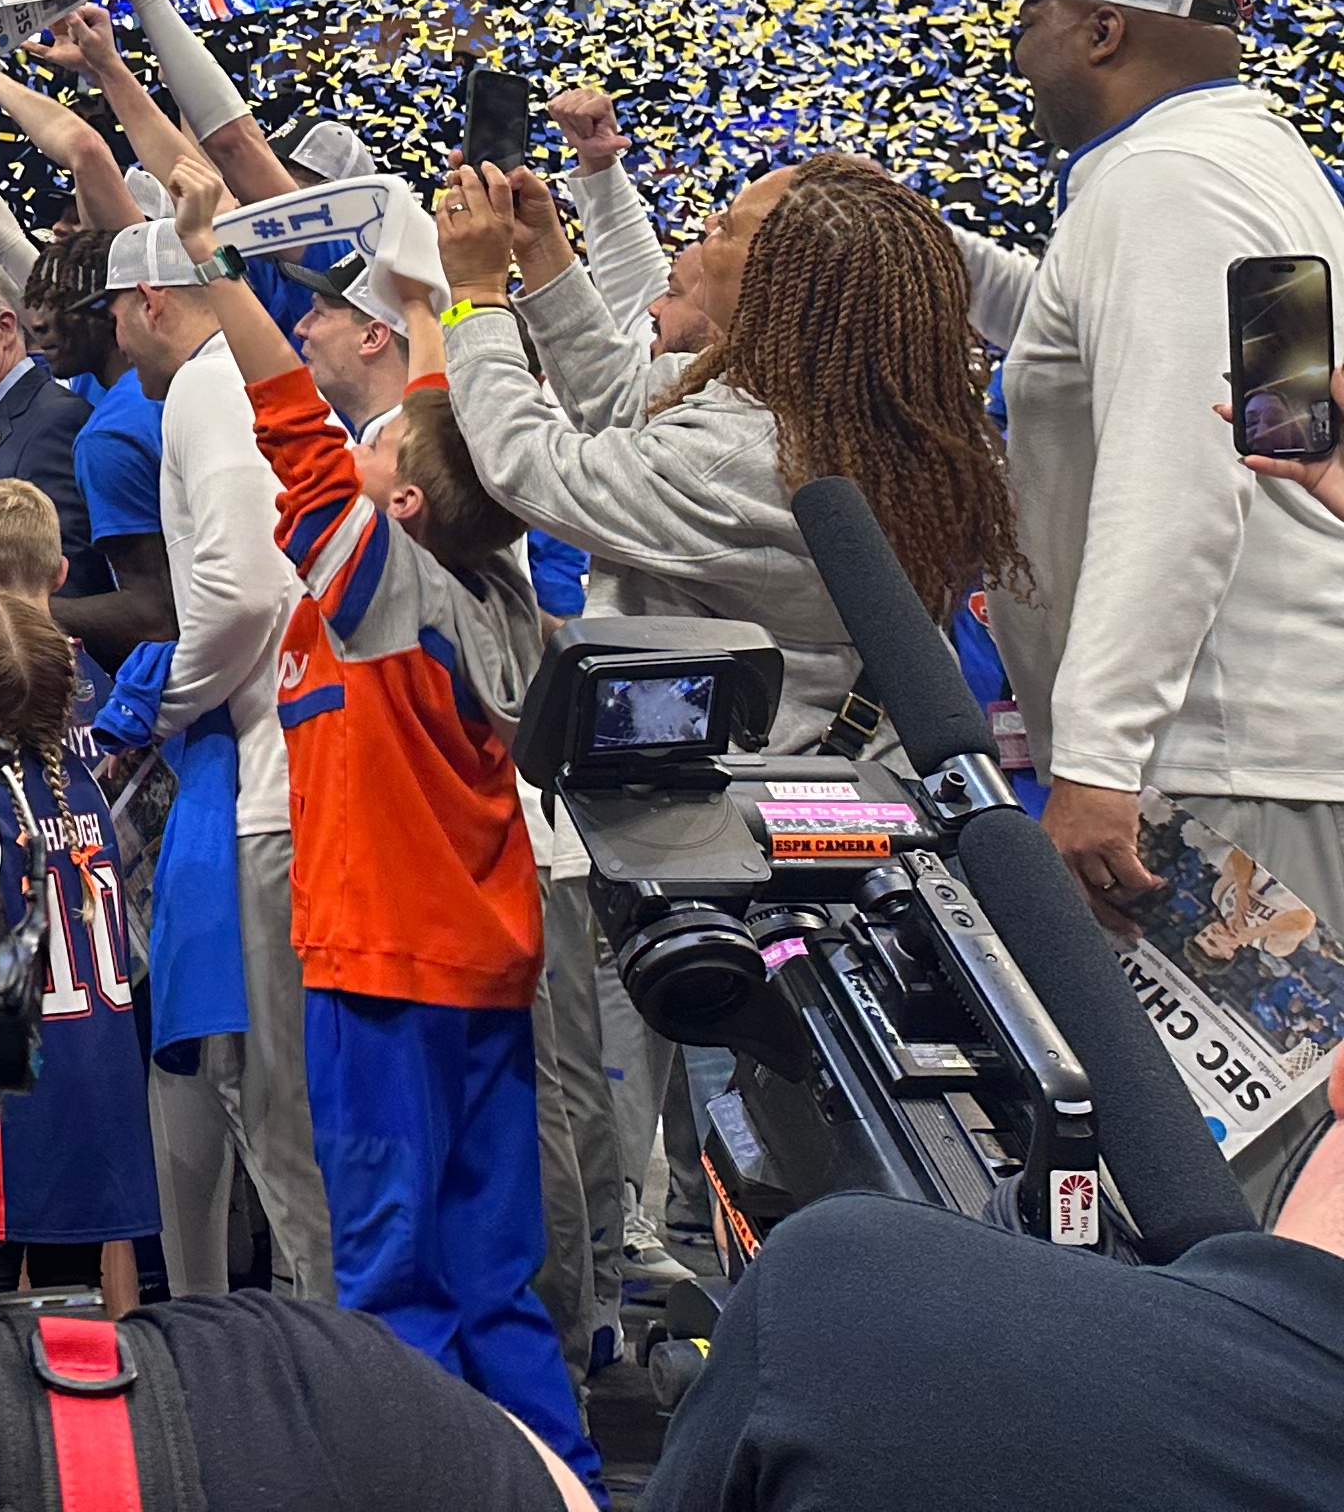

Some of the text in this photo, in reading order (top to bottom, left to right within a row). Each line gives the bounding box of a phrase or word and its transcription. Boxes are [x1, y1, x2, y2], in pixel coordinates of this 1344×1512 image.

[251, 203, 334, 239] #1
[774, 839, 889, 853] ESPN CAMERA 4
[40, 862, 133, 1017] 10
[1119, 953, 1272, 1112] SEC CHA
[1256, 1060, 1287, 1093] Florida
